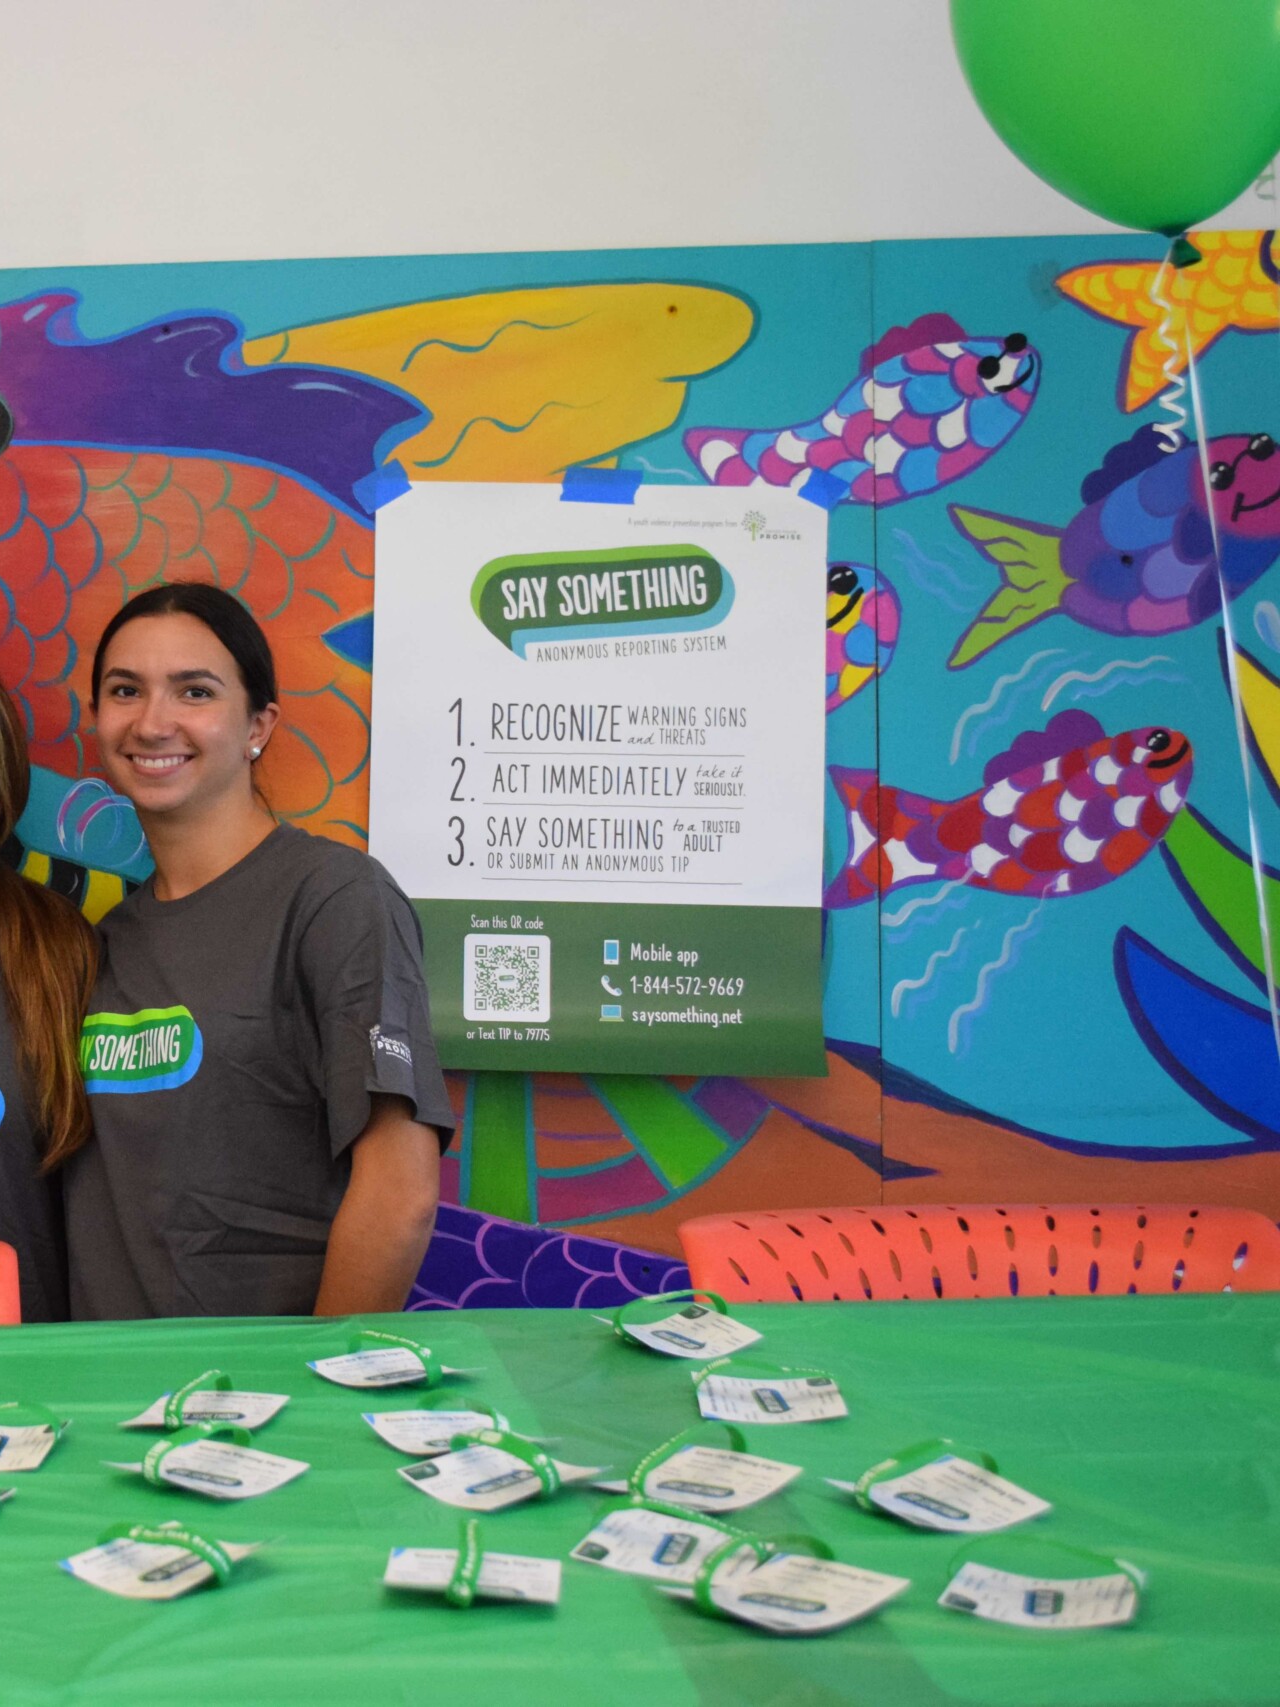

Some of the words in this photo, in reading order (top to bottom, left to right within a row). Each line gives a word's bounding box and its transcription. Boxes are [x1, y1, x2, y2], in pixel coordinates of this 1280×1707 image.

[501, 575, 547, 621] SAY
[557, 564, 707, 617] SOMETHING
[536, 643, 609, 663] ANONYMOUS
[615, 638, 677, 658] REPORTING
[683, 635, 727, 653] SYSTEM
[448, 697, 476, 747] 1.
[491, 703, 622, 743] RECOGNIZE
[627, 705, 696, 728] WARNING
[704, 707, 747, 728] SIGNS
[627, 730, 657, 746] and
[659, 729, 706, 747] THREATS
[450, 757, 476, 802] 2.
[492, 764, 531, 794] ACT
[542, 765, 688, 797] IMMEDIATELY
[696, 764, 726, 780] take
[730, 766, 743, 780] it
[693, 781, 747, 798] SERIOUSLY.
[673, 818, 684, 832] to
[687, 823, 696, 832] a
[701, 820, 741, 834] TRUSTED
[447, 816, 476, 867] 3.
[486, 816, 527, 848] SAY
[538, 818, 664, 851] SOMETHING
[683, 835, 723, 853] ADULT
[487, 853, 504, 870] OR
[509, 853, 555, 871] SUBMIT
[562, 854, 579, 871] AN
[585, 854, 664, 873] ANONYMOUS
[671, 856, 689, 874] TIP
[470, 914, 490, 929] Scan
[491, 915, 508, 930] this
[510, 916, 522, 930] QR
[524, 916, 544, 930] code
[630, 943, 673, 963] Mobile
[677, 949, 699, 967] app
[630, 976, 744, 997] 1-844-572-9669
[632, 1008, 743, 1028] saysomething.net
[466, 1030, 475, 1040] or
[478, 1027, 496, 1040] Text
[498, 1027, 511, 1040] TIP
[513, 1028, 523, 1041] to
[525, 1028, 550, 1042] 79775
